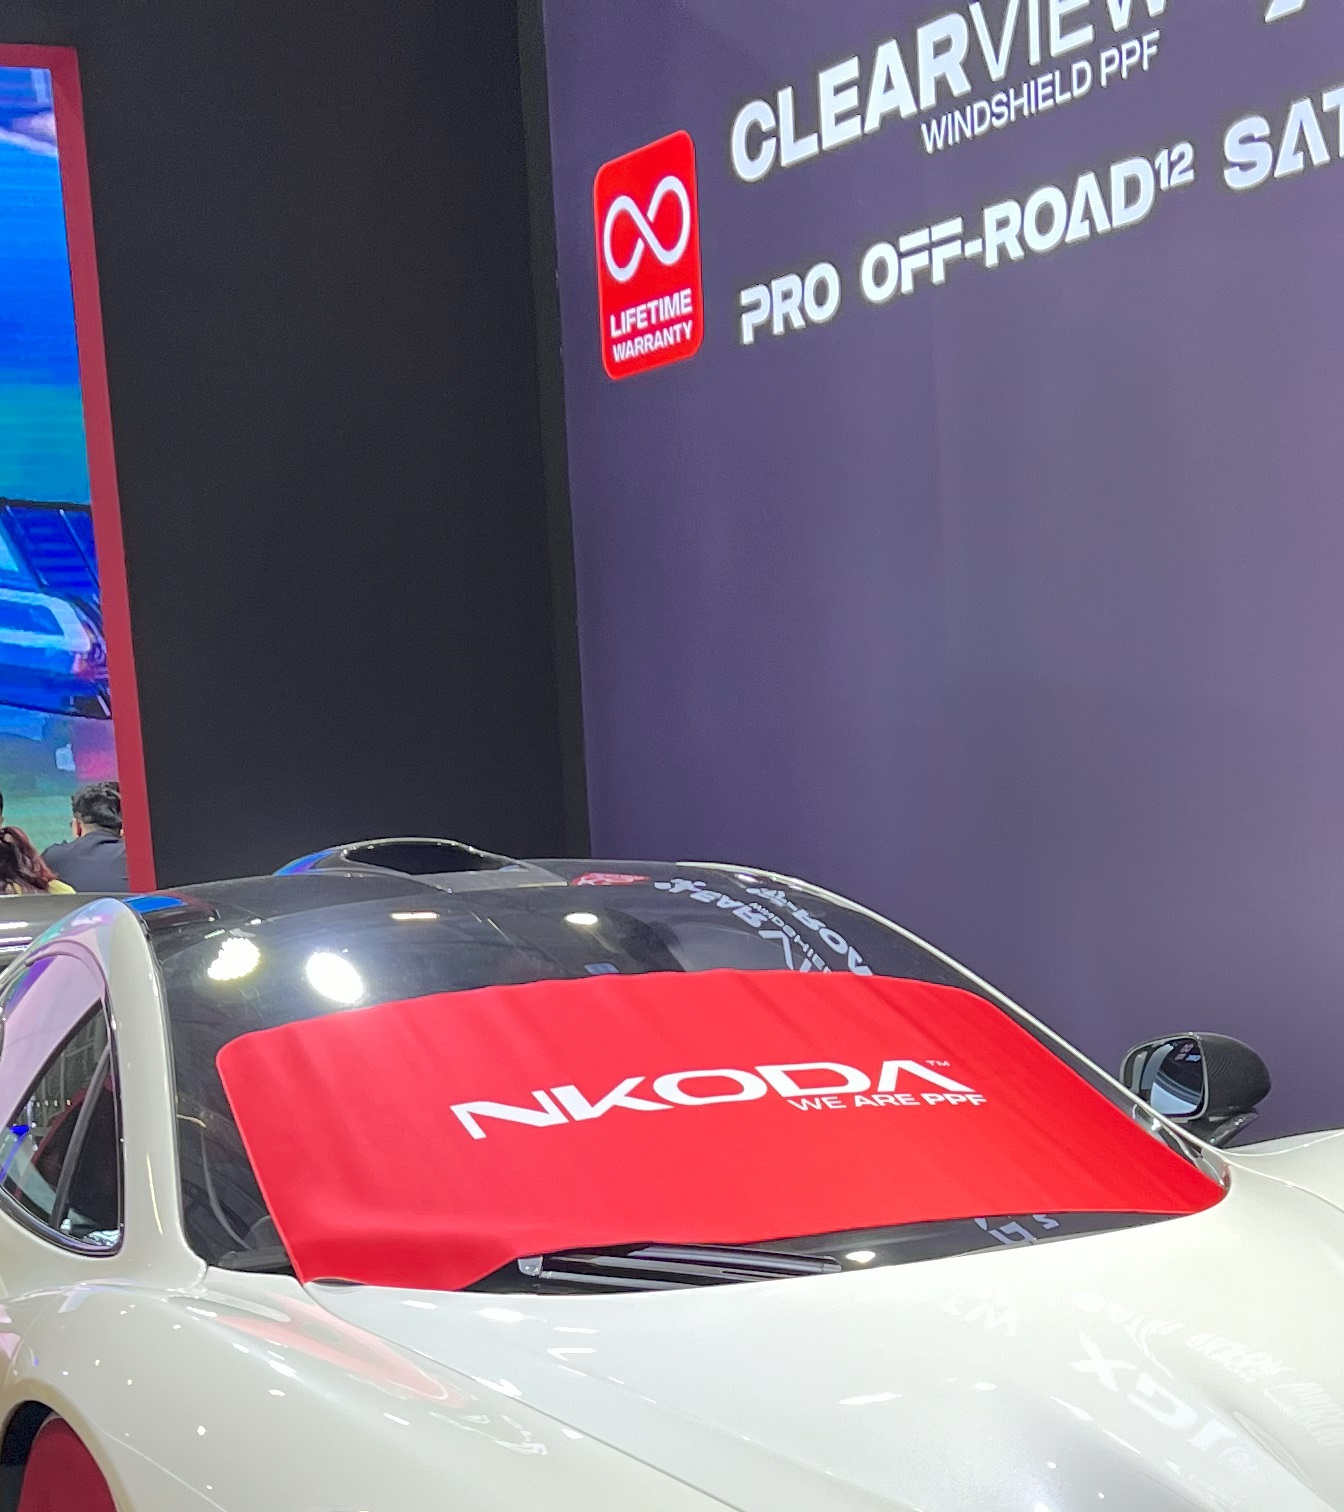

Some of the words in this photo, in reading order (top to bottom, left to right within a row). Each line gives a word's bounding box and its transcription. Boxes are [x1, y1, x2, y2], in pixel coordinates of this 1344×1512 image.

[921, 60, 1092, 154] WINDSHIELD
[1100, 30, 1161, 88] PPF
[609, 288, 693, 337] LIFETIME
[740, 261, 841, 345] PRO
[612, 320, 693, 363] WARRANTY
[787, 1096, 847, 1111] WE
[855, 1093, 920, 1107] ARE
[921, 1093, 987, 1105] PPF
